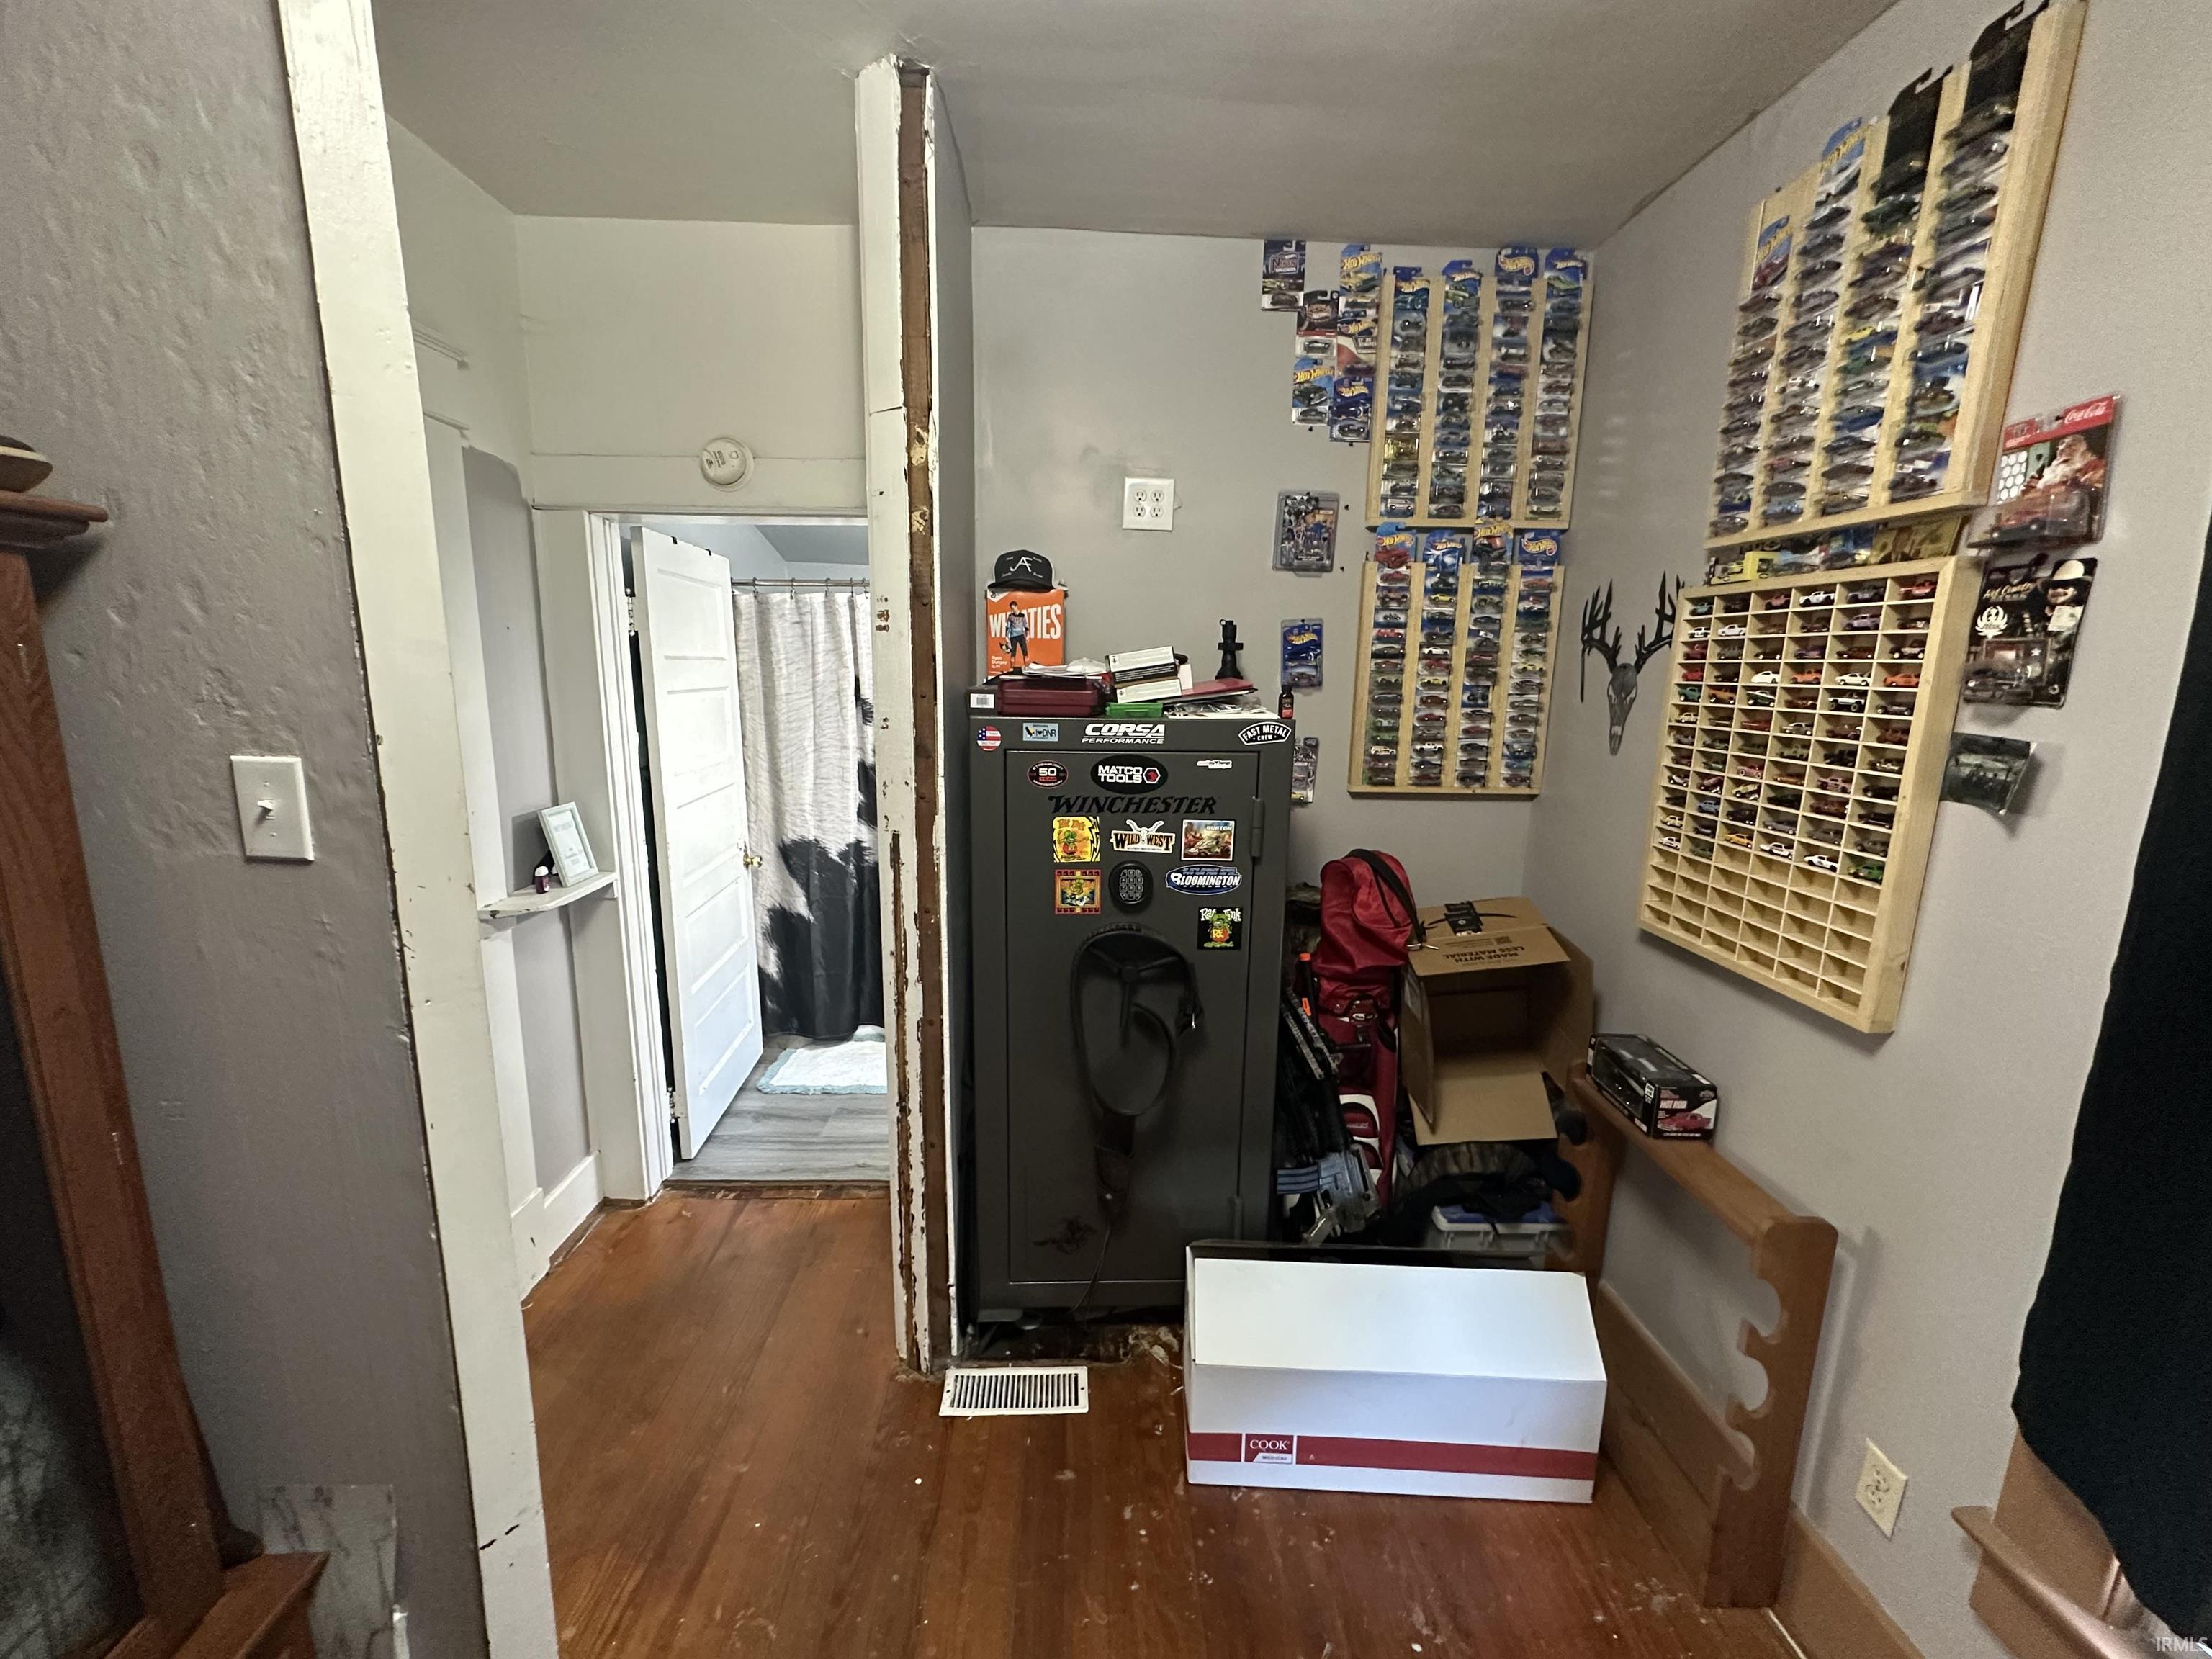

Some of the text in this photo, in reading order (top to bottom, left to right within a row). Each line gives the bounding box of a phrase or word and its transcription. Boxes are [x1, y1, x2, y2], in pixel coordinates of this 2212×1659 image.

[1042, 729, 1056, 737] DNR
[1084, 723, 1165, 738] CORSA
[1242, 724, 1287, 741] FAST METAL
[1038, 768, 1057, 777] 50
[1097, 765, 1143, 775] MATCO
[1097, 773, 1143, 783] TOOLS
[1048, 794, 1218, 815] WINCHESTER
[1113, 832, 1173, 851] WILD WEST
[1170, 873, 1241, 886] BLOOMINGTON
[1442, 949, 1497, 959] MATERIAL
